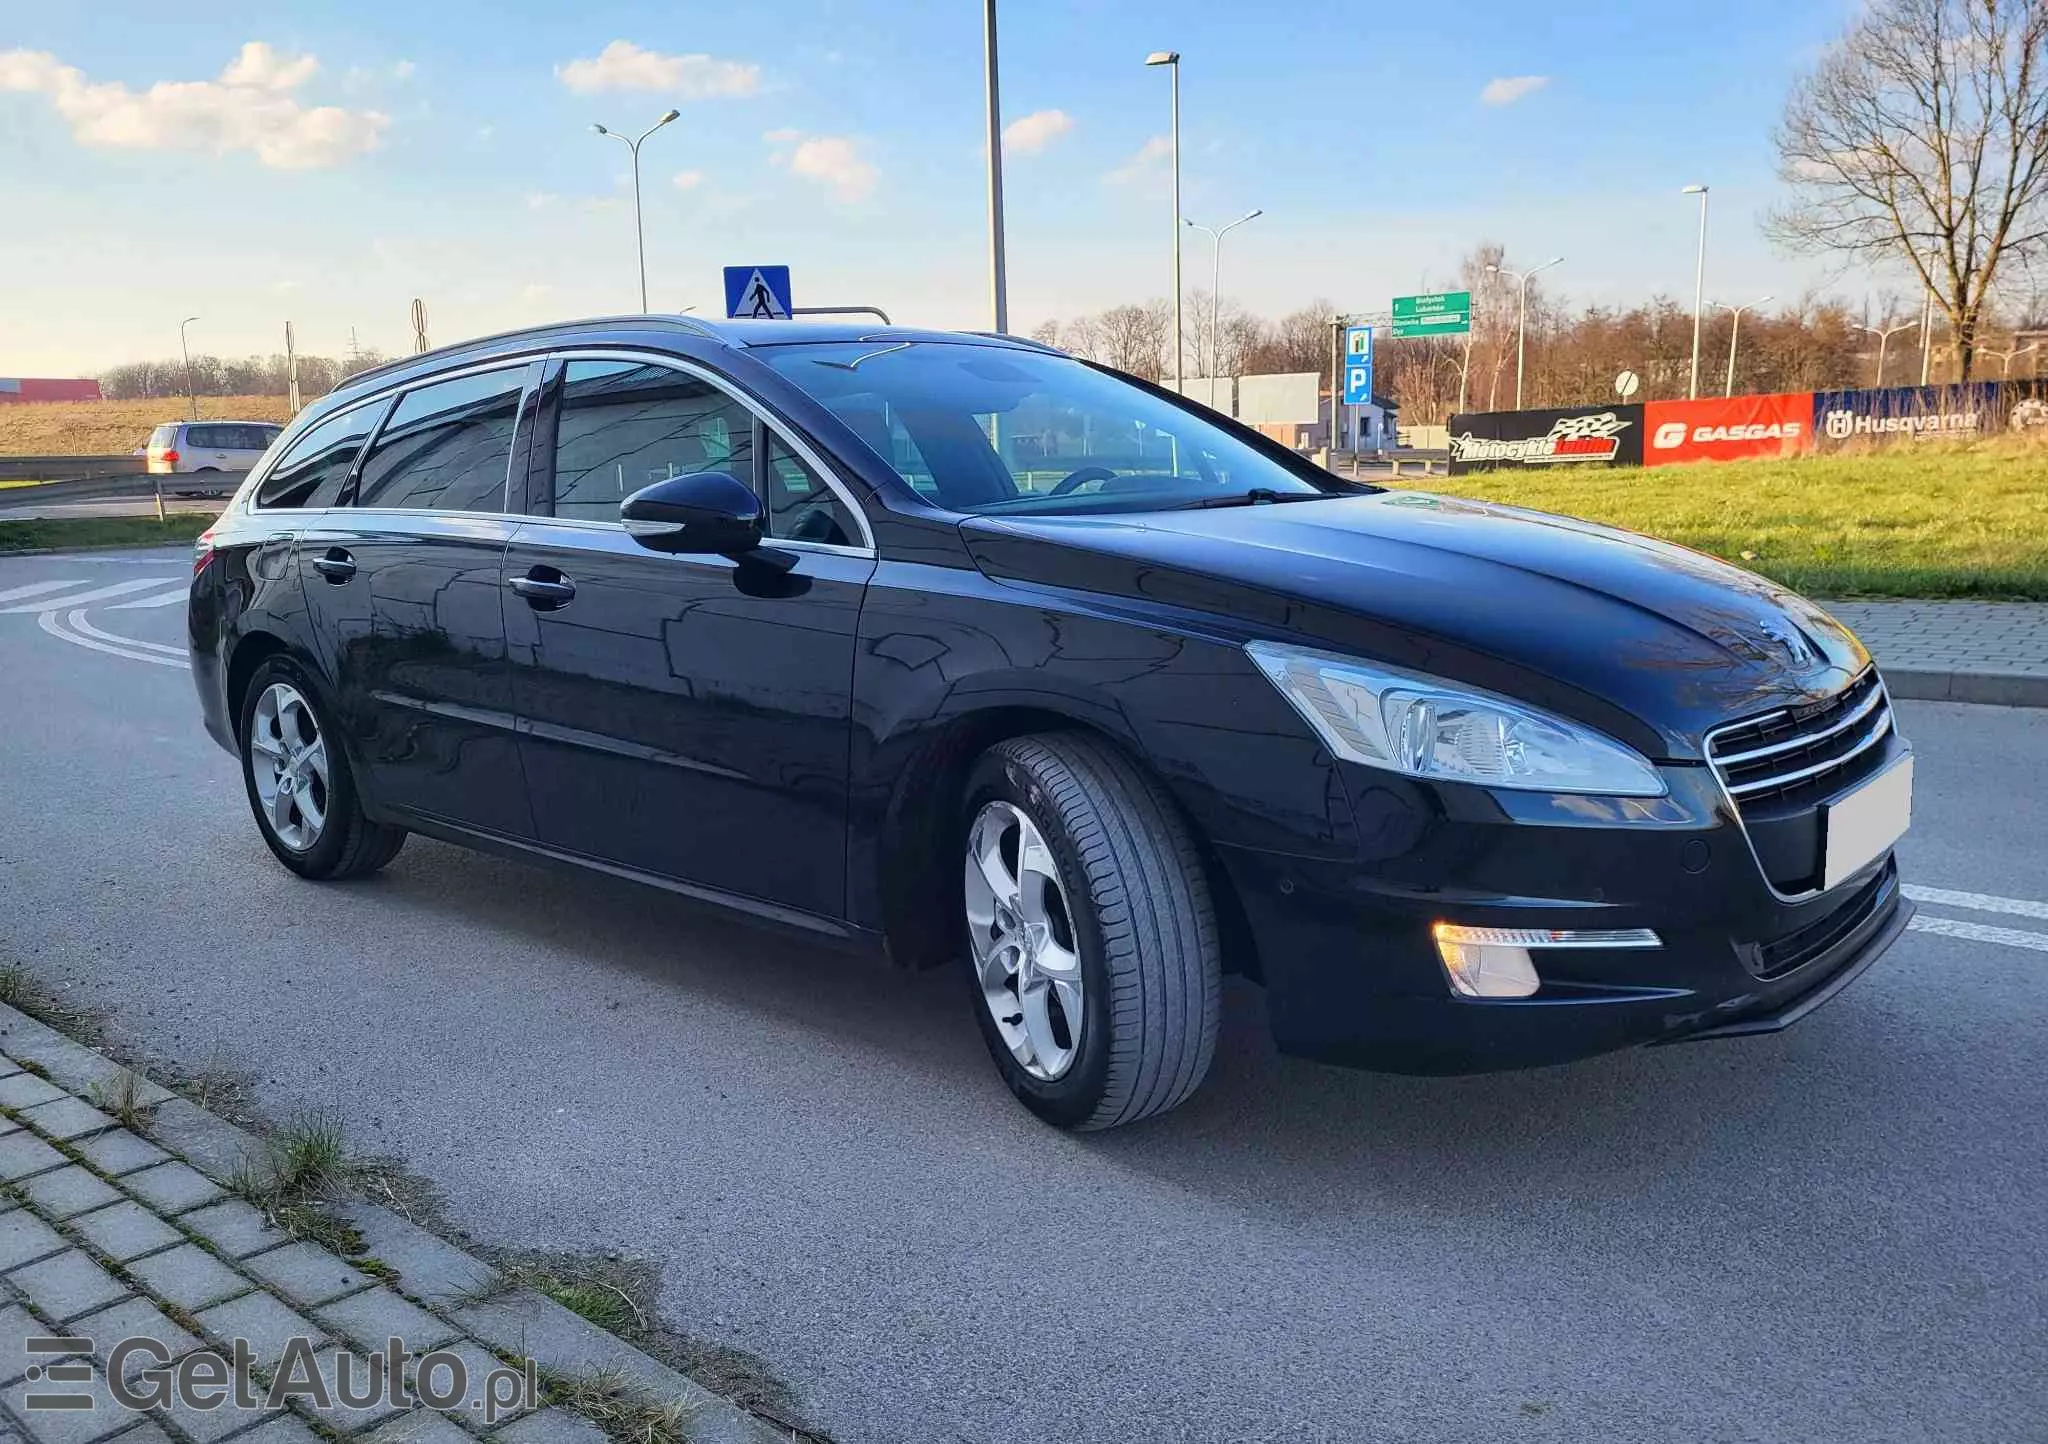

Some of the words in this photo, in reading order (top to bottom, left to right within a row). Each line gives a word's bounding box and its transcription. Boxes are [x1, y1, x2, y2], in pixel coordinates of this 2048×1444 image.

[1350, 368, 1367, 393] P
[1692, 422, 1801, 442] GASGAS
[1855, 413, 1978, 438] Husqvarna
